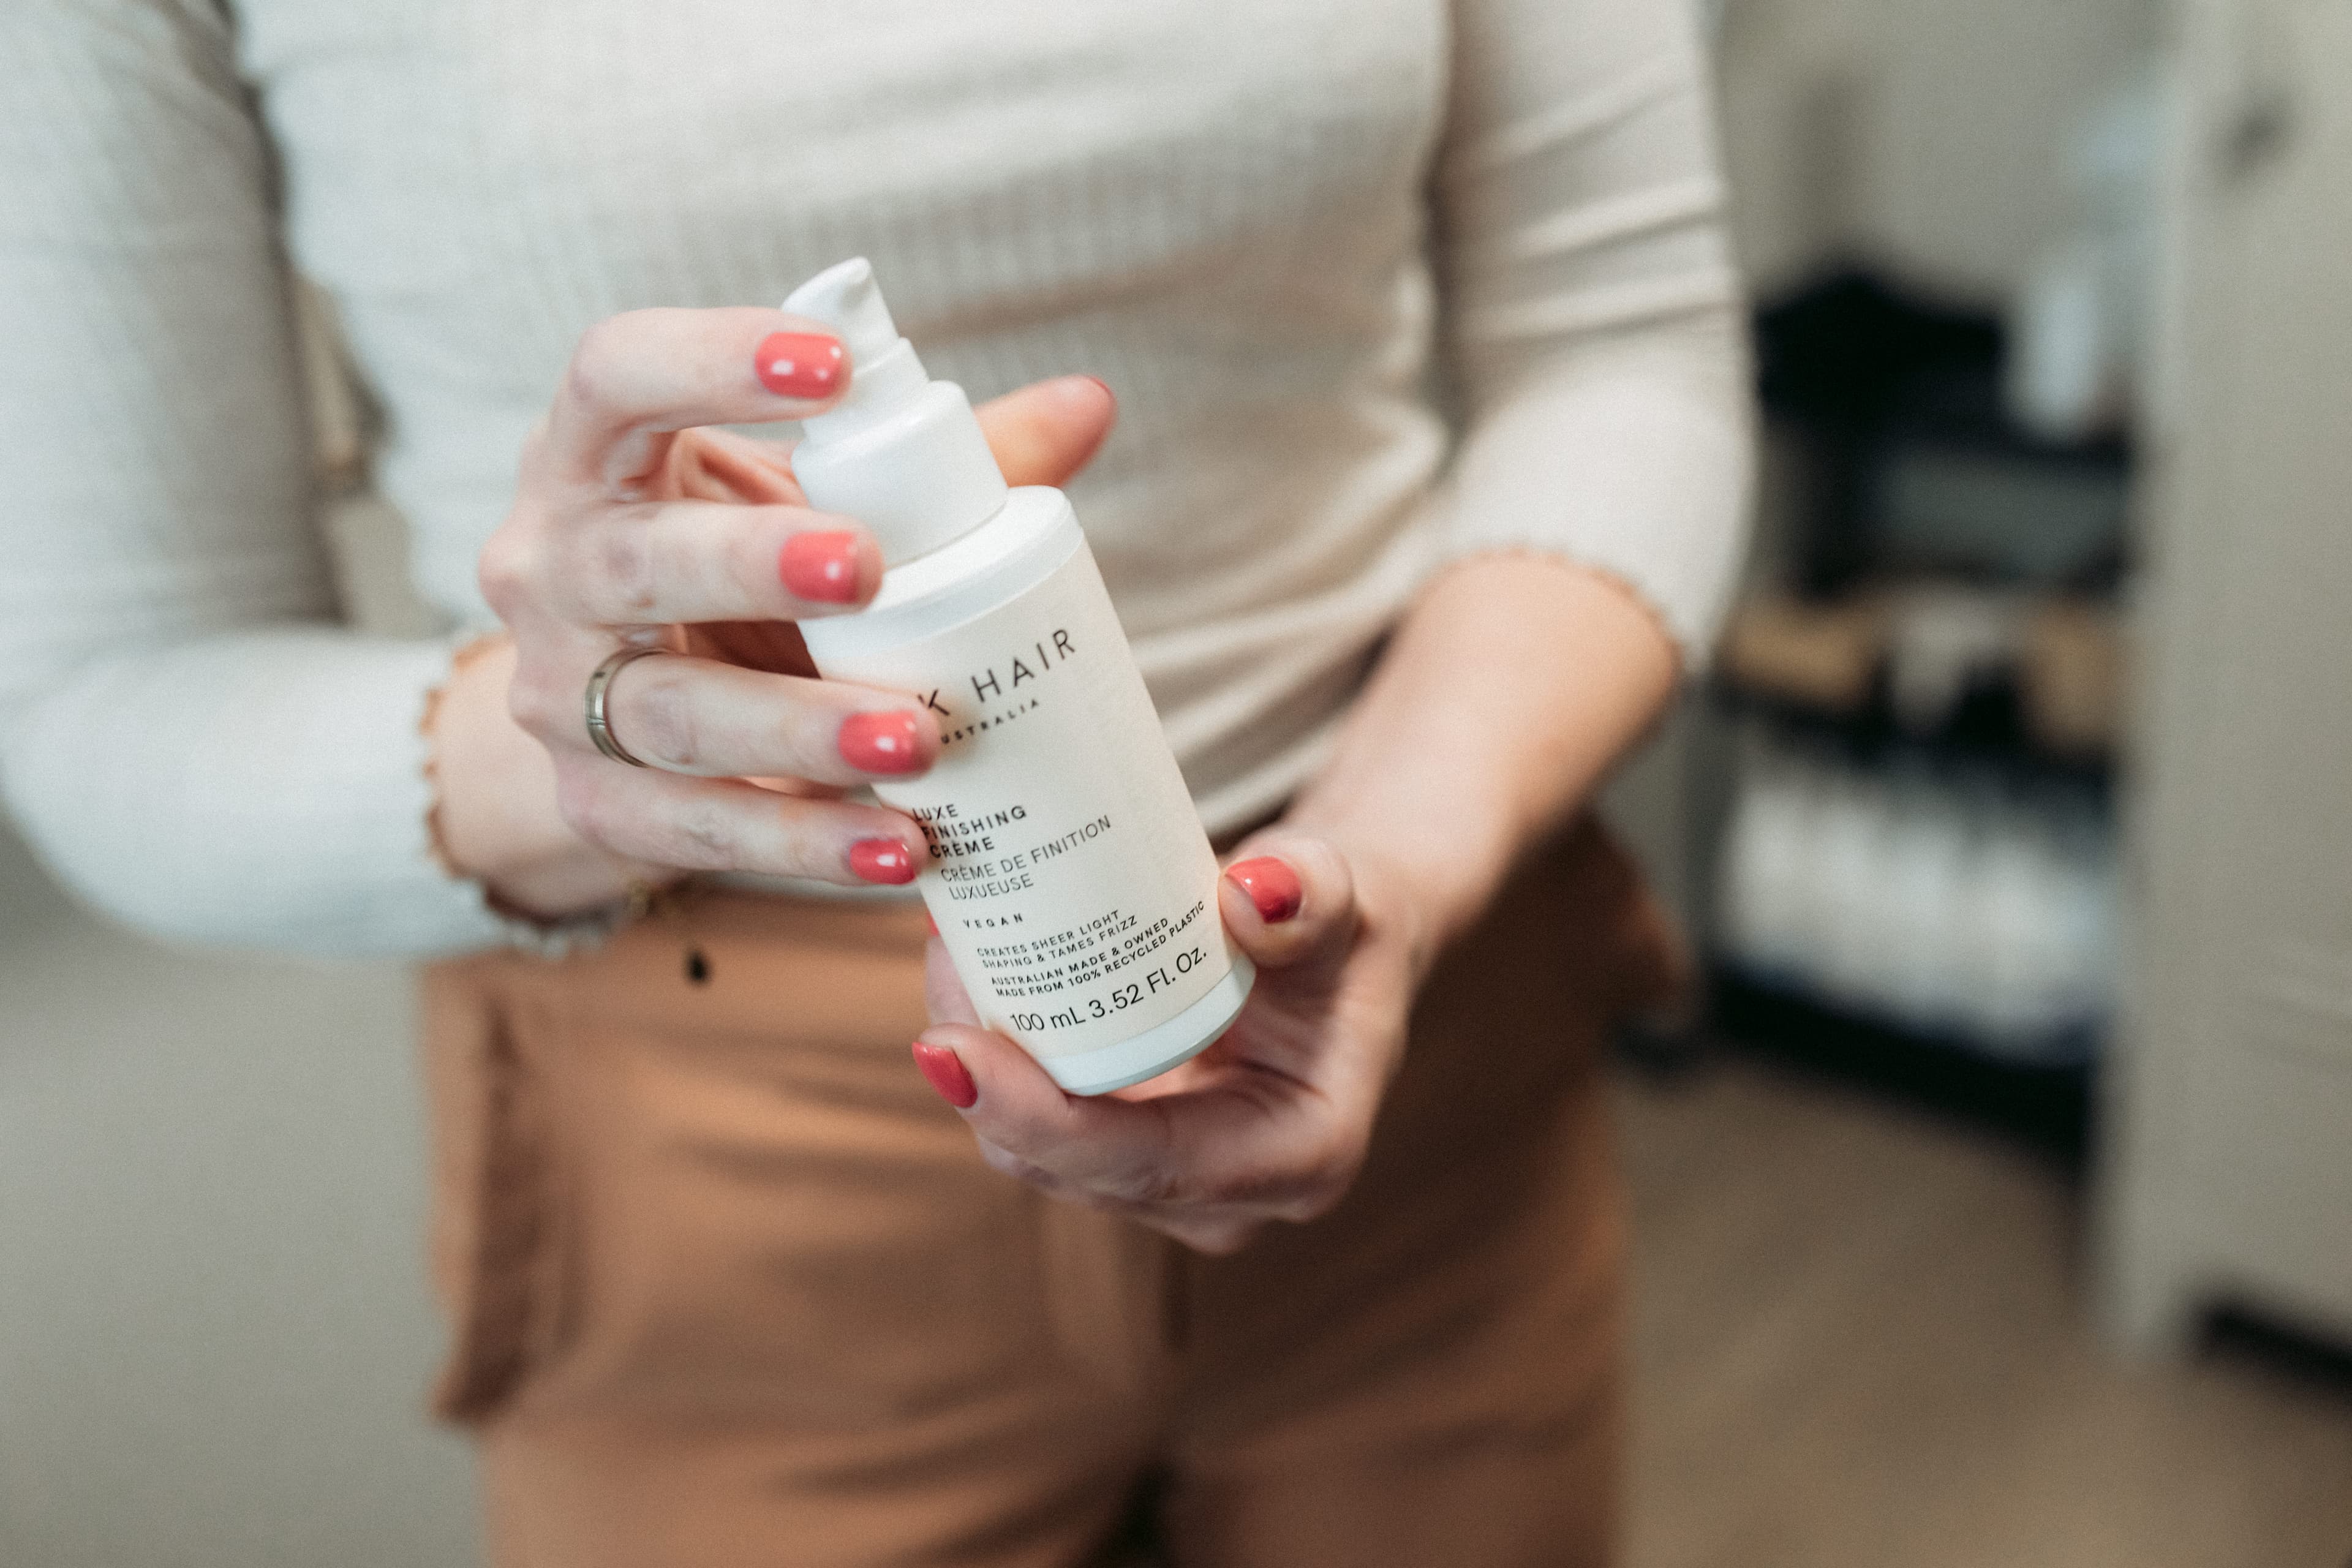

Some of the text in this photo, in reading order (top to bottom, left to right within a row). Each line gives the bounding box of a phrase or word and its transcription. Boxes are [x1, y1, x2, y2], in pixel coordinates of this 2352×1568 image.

[971, 628, 1075, 703] HAIR
[940, 699, 1039, 744] USTRALIA
[912, 804, 959, 822] LUXE
[921, 805, 1027, 840] FINISHING
[1000, 854, 1027, 873] DE
[1030, 815, 1112, 864] FINITION
[949, 873, 1034, 900] LUXUEUSE
[963, 913, 1023, 929] VEGAN
[977, 910, 1119, 957] CREATES SHEER LIGHT
[982, 915, 1137, 969] SHAPING & TAMES FRIZZ
[991, 918, 1169, 986] AUSTRALIAN MADE & OWNED
[995, 900, 1205, 997] MADE FROM 100% RECYCLED PLASTIC
[1010, 947, 1207, 1031] 100 mL 3.52 Fl. Oz.
